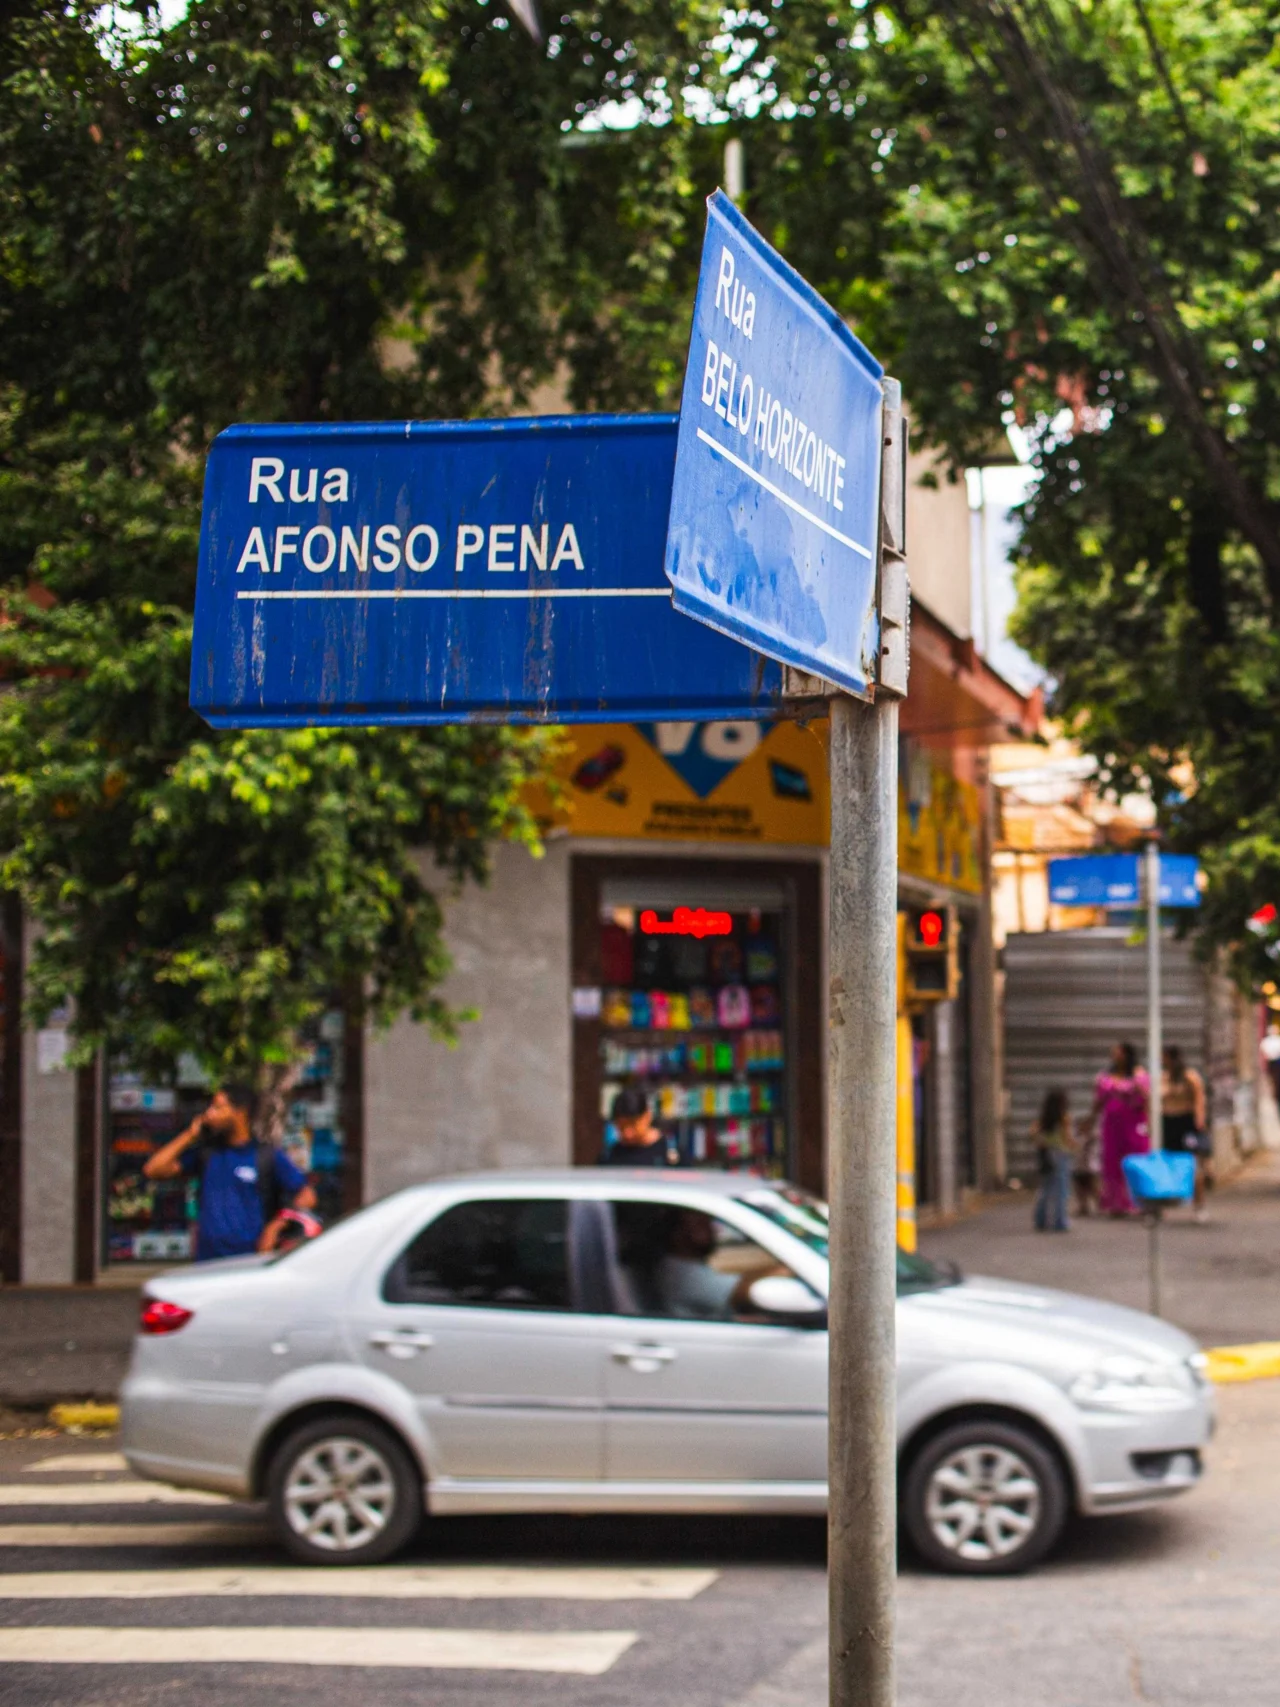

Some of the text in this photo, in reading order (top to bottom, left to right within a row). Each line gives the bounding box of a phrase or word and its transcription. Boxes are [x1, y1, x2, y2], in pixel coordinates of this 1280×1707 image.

[715, 245, 757, 341] Rua
[701, 339, 846, 512] BELO HORIZONTE
[248, 456, 349, 503] Rua
[235, 522, 585, 574] AFONSO PENA
